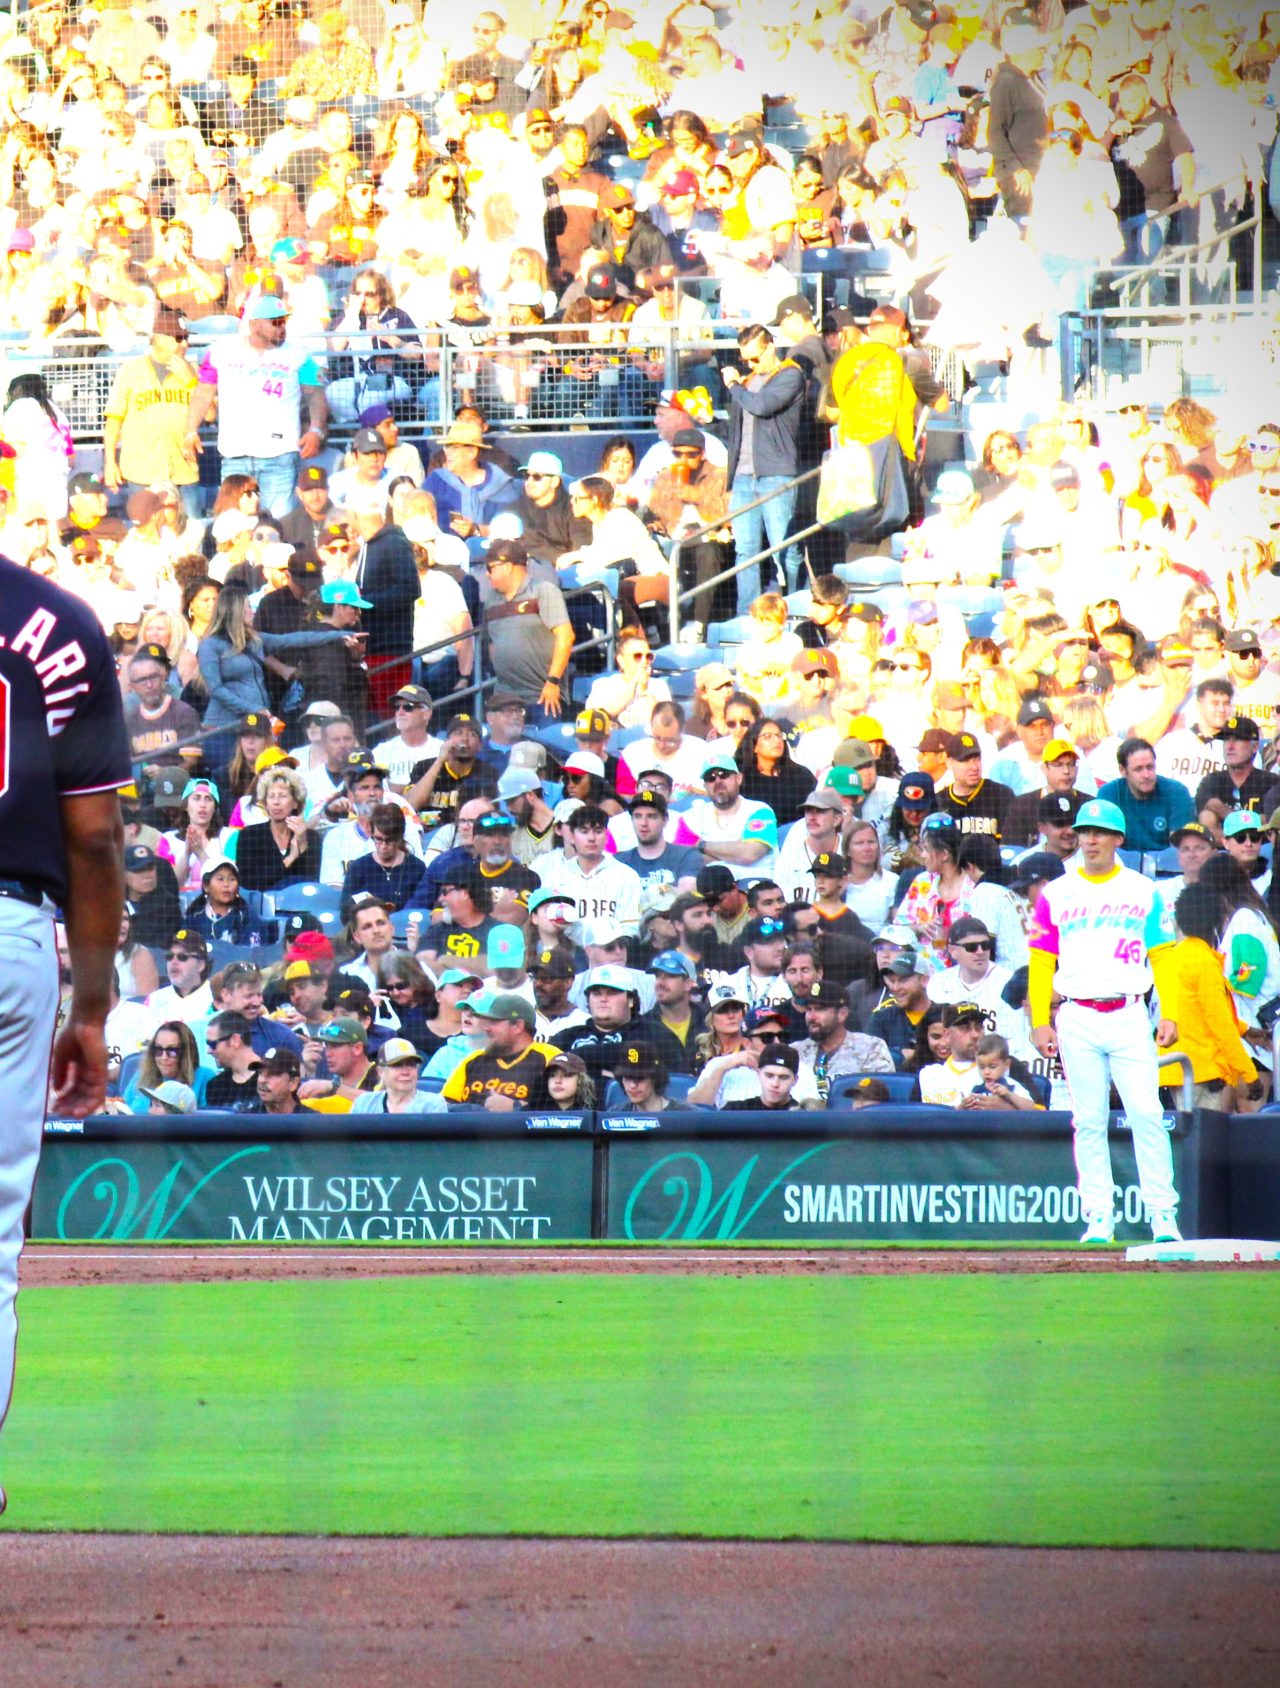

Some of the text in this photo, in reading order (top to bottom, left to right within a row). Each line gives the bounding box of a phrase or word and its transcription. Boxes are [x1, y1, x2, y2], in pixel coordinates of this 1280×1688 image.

[166, 389, 191, 405] DIE
[262, 380, 284, 398] 44
[1113, 938, 1142, 964] 46
[531, 1118, 581, 1129] Van Wagner
[608, 1119, 656, 1130] Van Wagner
[242, 1176, 537, 1213] WILSEY ASSET
[783, 1184, 1152, 1225] SMARTINVESTING200CO
[228, 1215, 552, 1240] MANAGEMENT
